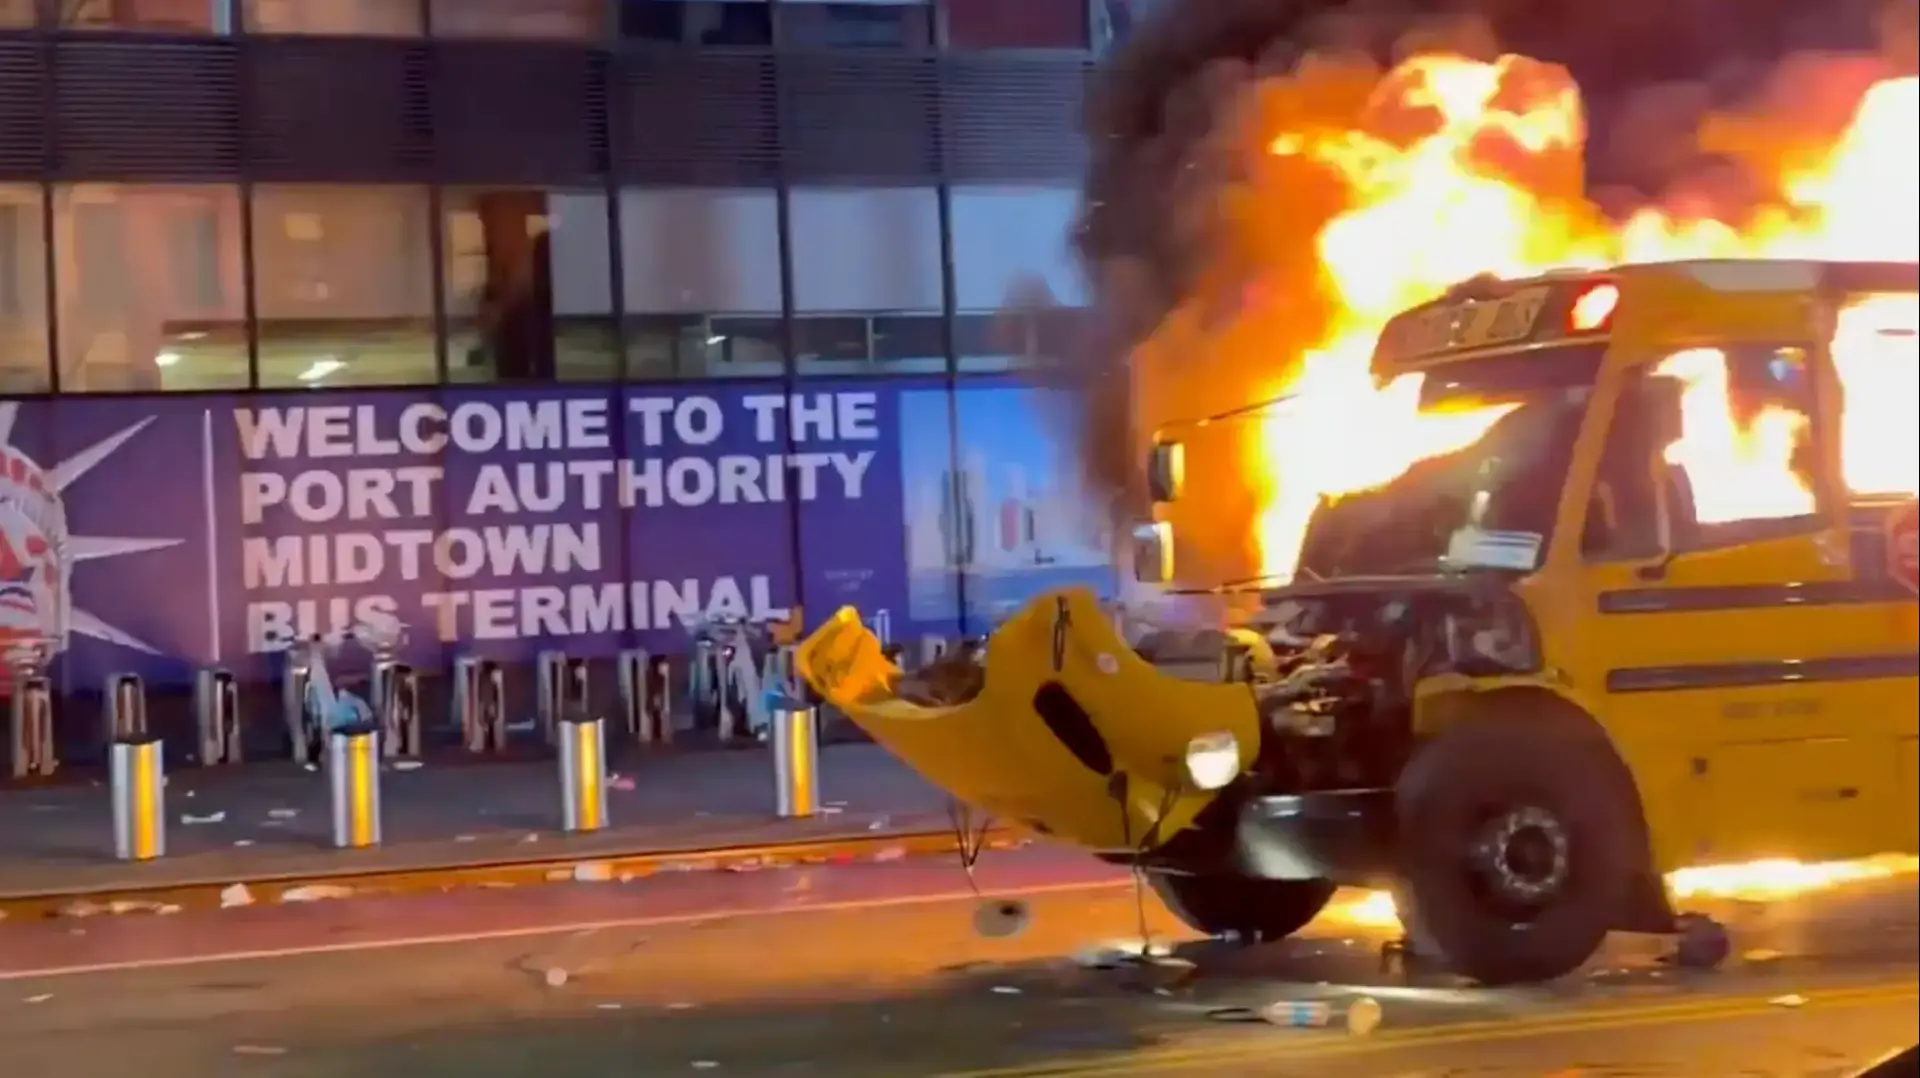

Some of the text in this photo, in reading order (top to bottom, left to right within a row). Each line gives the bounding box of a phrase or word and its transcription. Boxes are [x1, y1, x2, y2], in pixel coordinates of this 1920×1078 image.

[233, 392, 879, 459] WELCOME TO THE
[240, 451, 876, 524] PORT AUTHORITY
[242, 522, 600, 590] MIDTOWN
[247, 574, 790, 654] BUS TERMINAL
